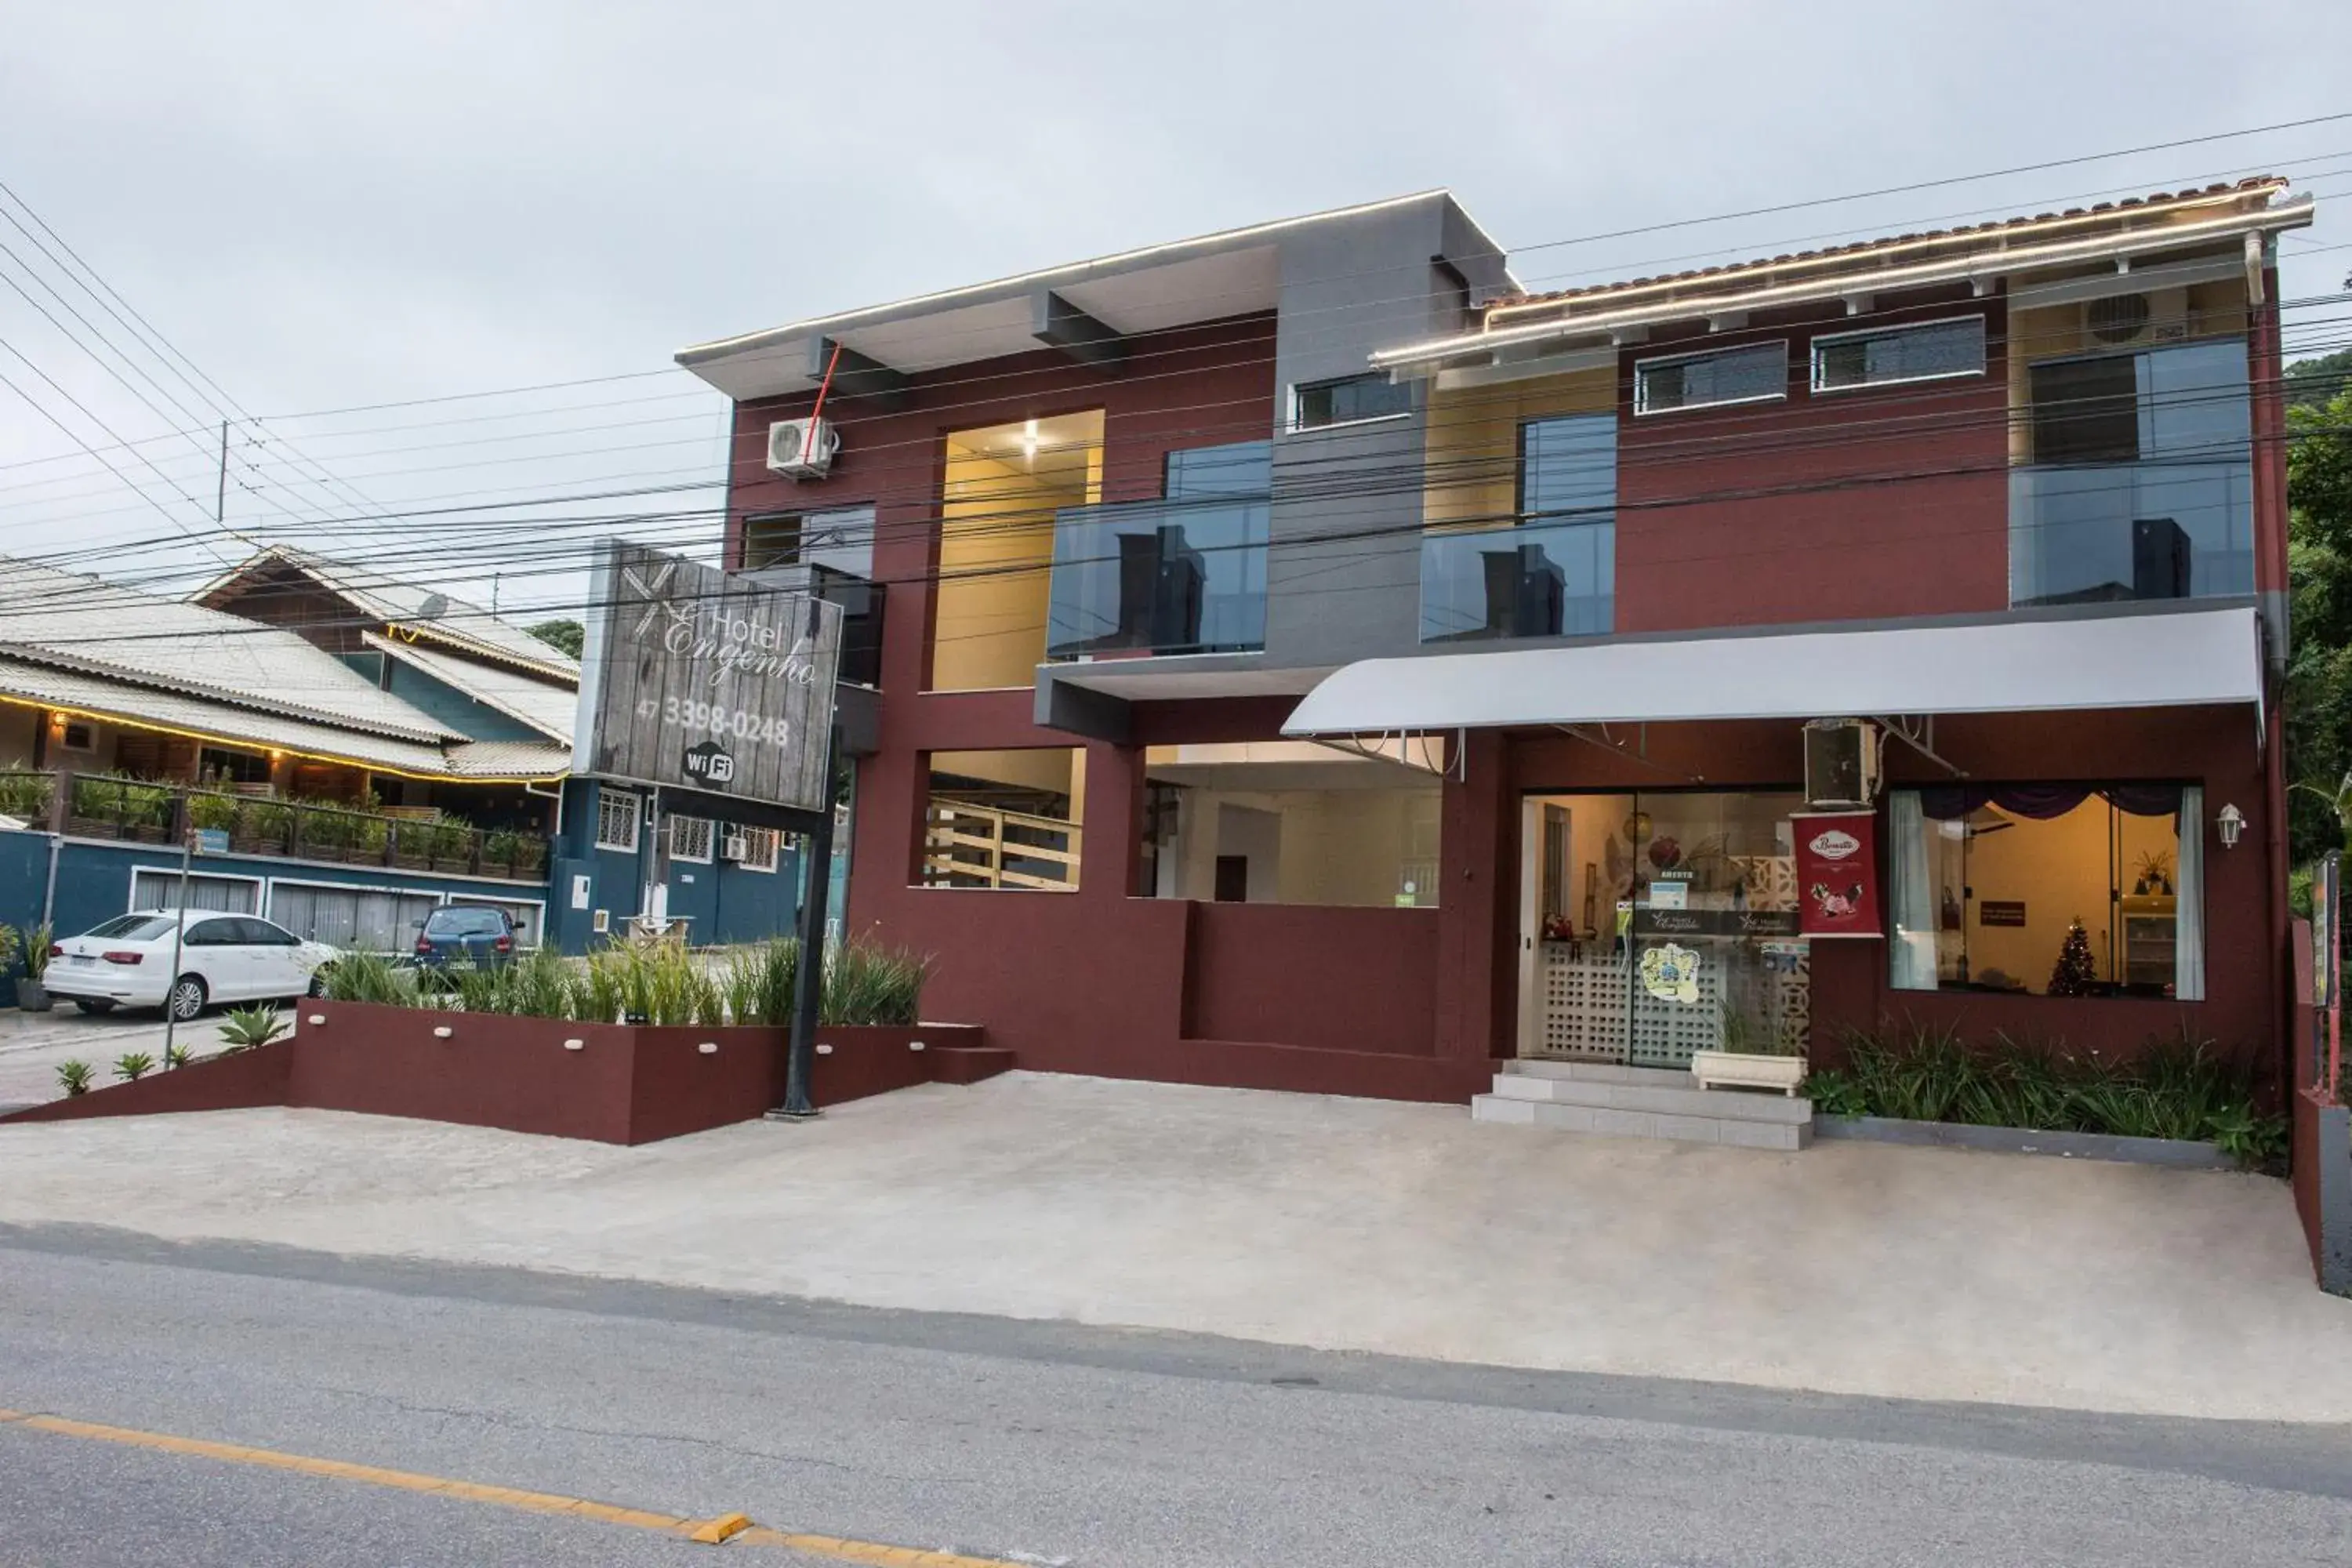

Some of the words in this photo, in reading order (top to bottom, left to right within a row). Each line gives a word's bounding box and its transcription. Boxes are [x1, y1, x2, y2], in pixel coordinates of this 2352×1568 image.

[664, 601, 815, 686] Engenho
[711, 605, 783, 652] Hotel
[637, 699, 659, 720] 47
[664, 695, 789, 746] 3398-0248
